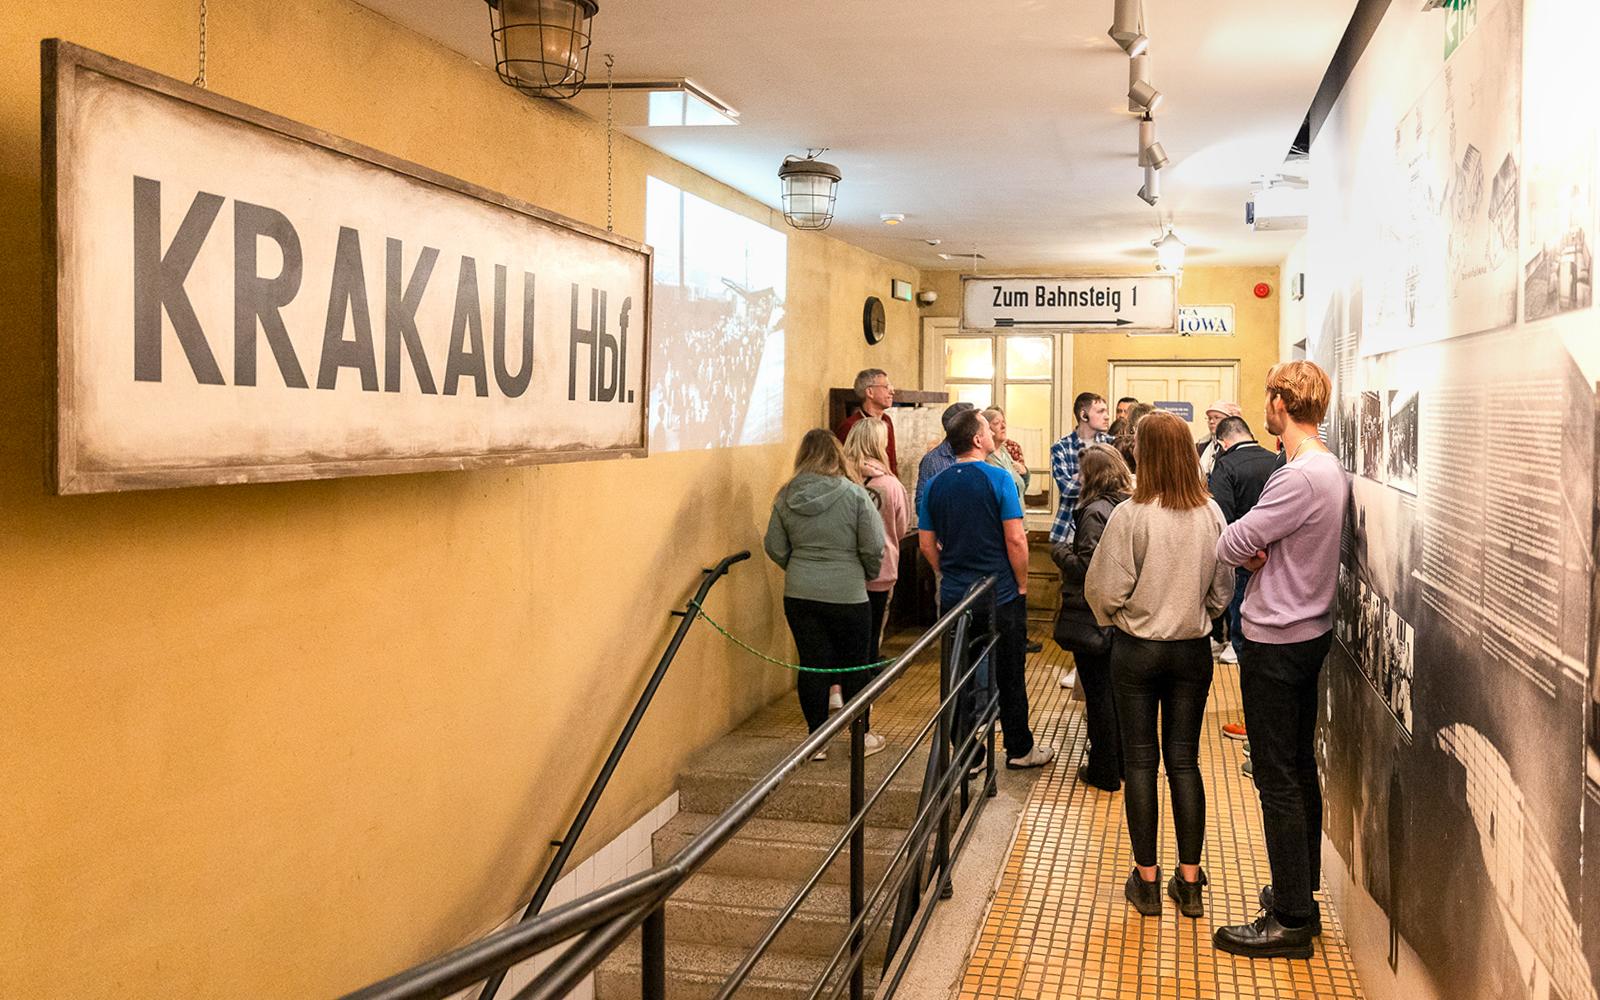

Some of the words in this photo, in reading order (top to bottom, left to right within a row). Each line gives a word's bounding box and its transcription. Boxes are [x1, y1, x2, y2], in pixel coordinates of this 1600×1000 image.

[133, 174, 535, 398] KRAKAU
[567, 282, 635, 404] Hbf.
[992, 285, 1029, 307] Zum
[1035, 285, 1121, 313] Bahnsteig
[1131, 285, 1138, 307] 1
[1178, 308, 1199, 316] ICA
